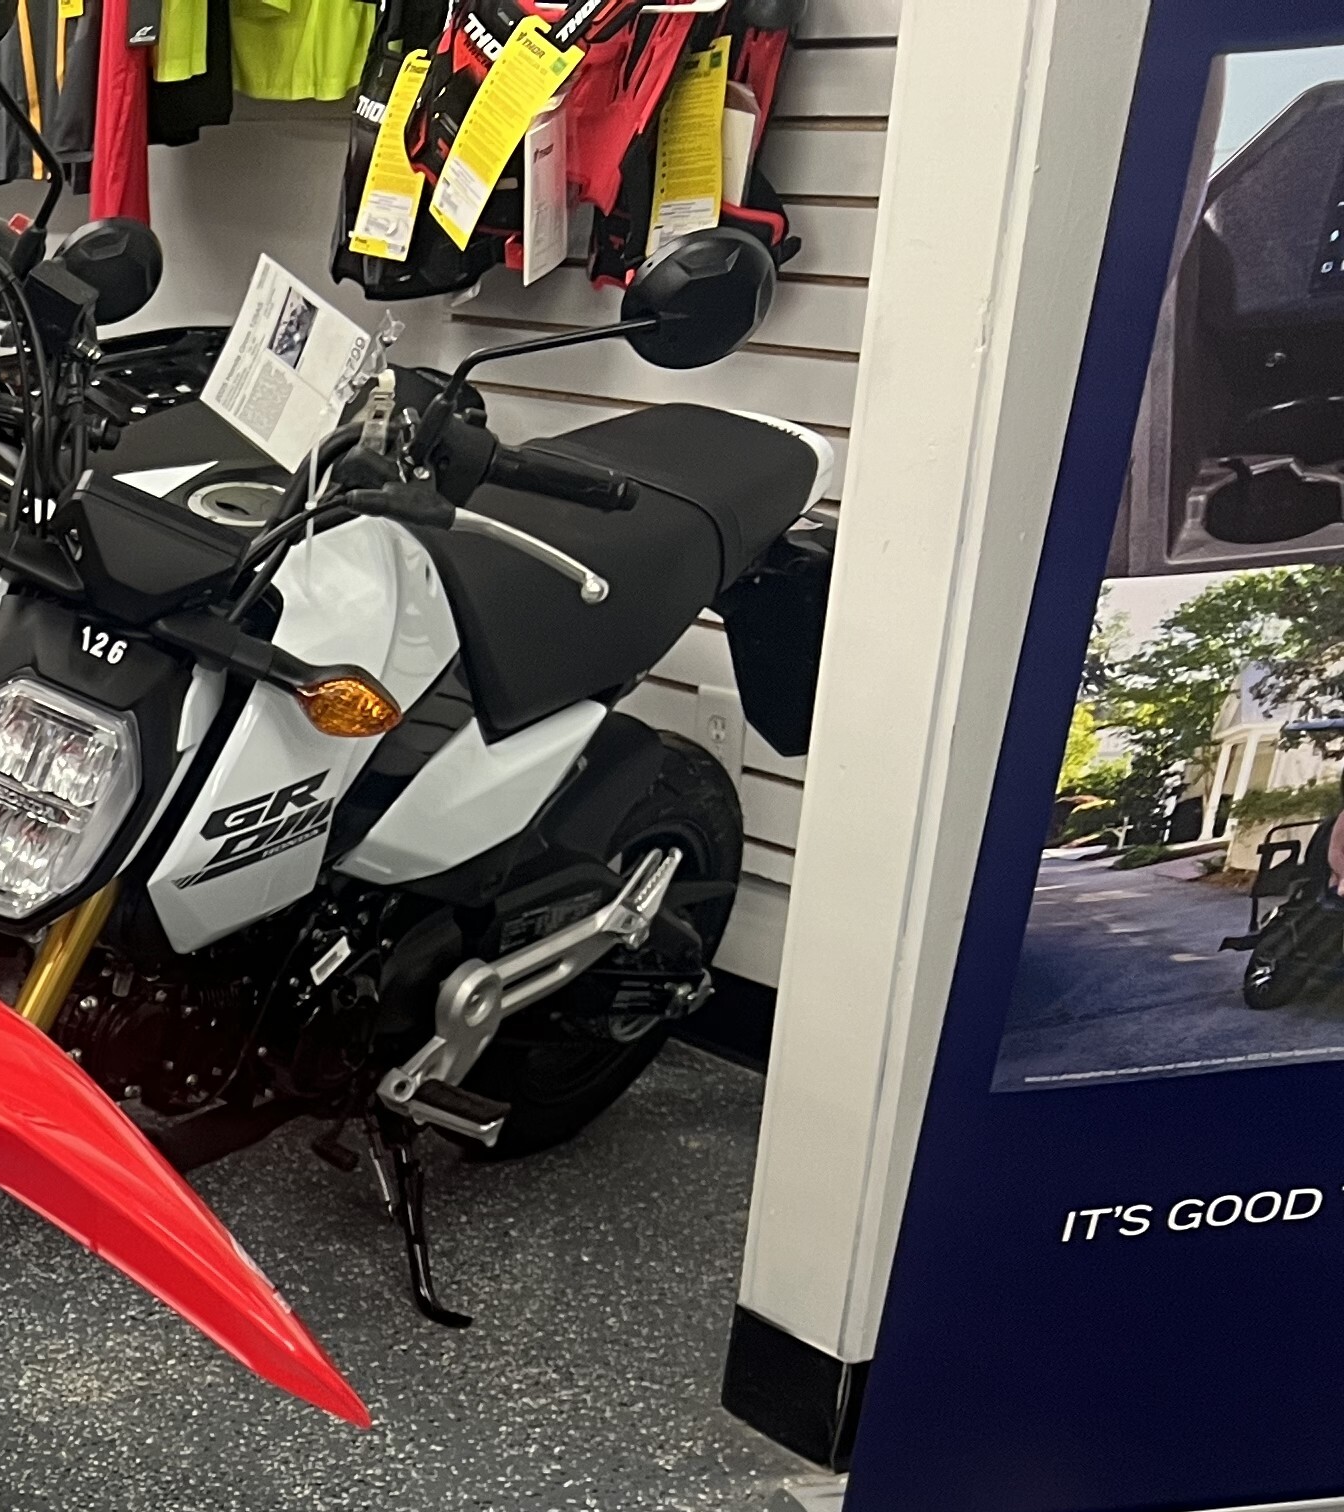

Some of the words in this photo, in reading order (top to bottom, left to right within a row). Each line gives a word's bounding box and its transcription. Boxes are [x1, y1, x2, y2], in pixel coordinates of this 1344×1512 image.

[463, 13, 505, 62] THO
[556, 0, 602, 42] THO
[356, 95, 387, 125] THO
[82, 625, 128, 665] 126
[1062, 1203, 1154, 1243] IT'S
[1167, 1187, 1324, 1232] GOOD
